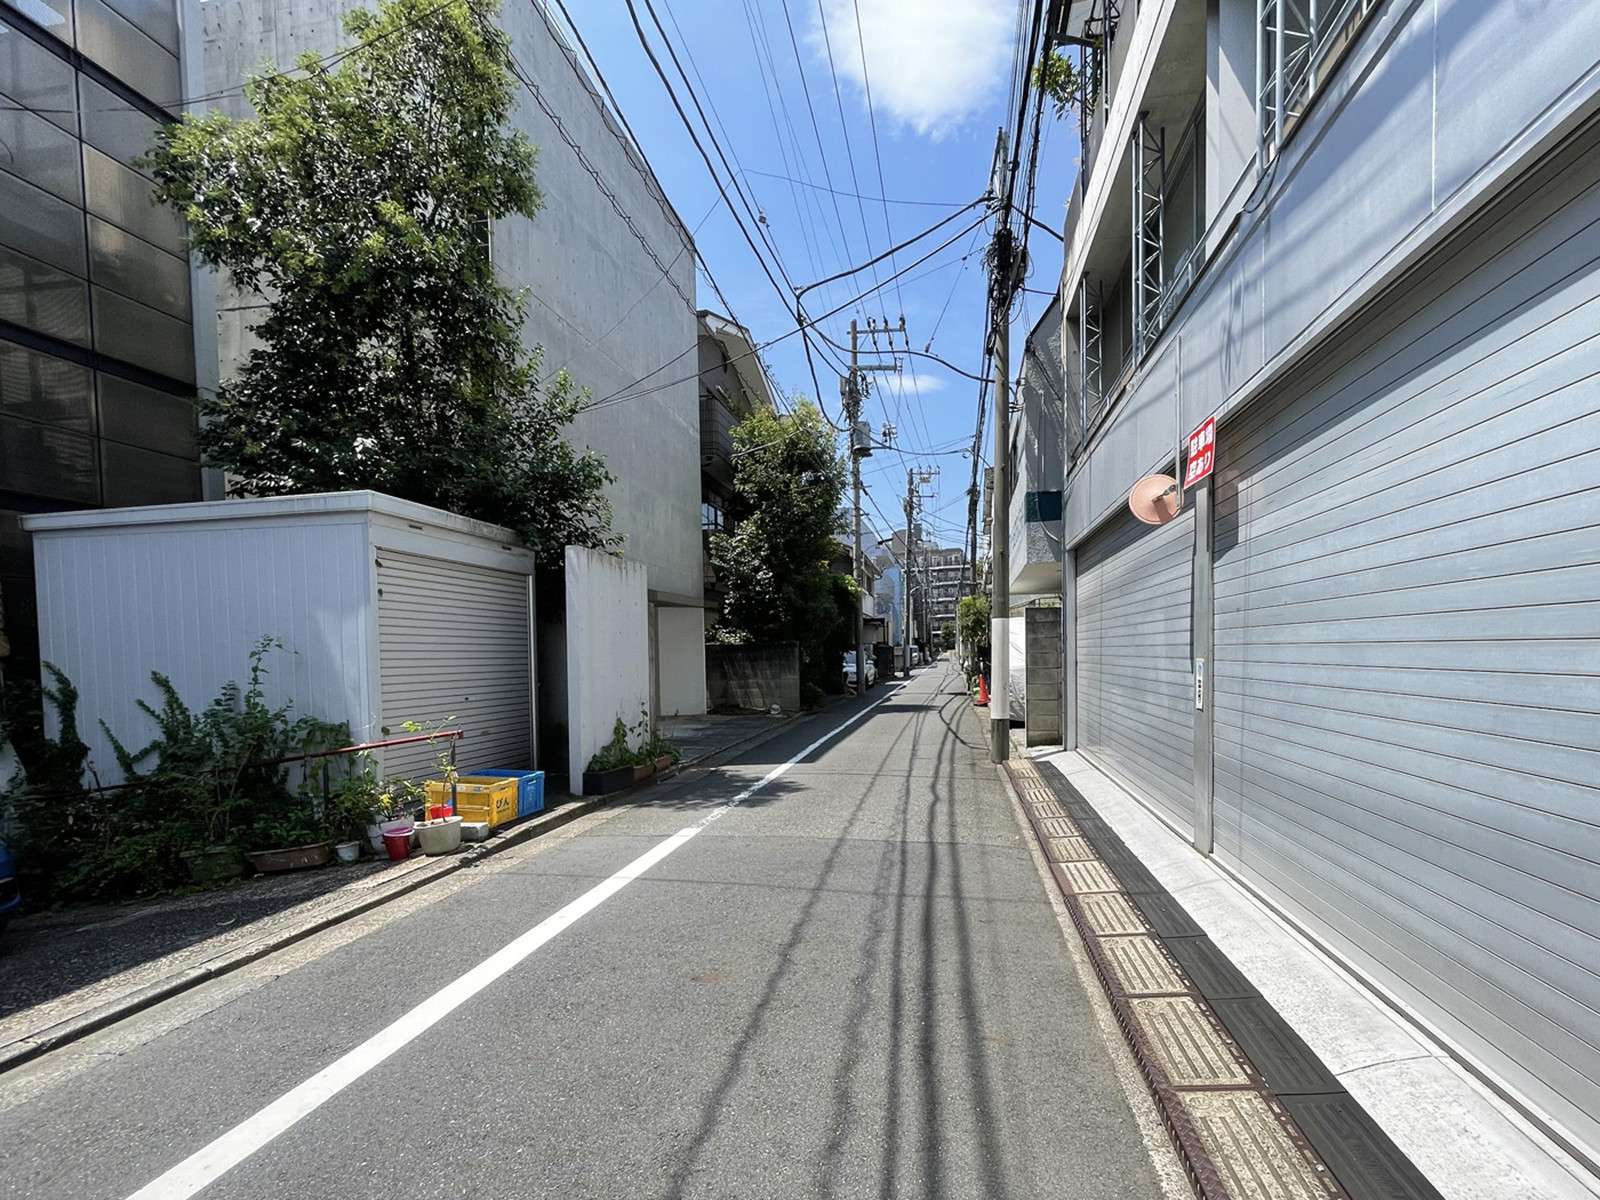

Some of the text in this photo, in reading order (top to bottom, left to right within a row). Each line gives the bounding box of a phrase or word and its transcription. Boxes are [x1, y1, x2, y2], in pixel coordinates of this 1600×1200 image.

[1187, 451, 1211, 480] 空あり
[496, 797, 510, 809] びん
